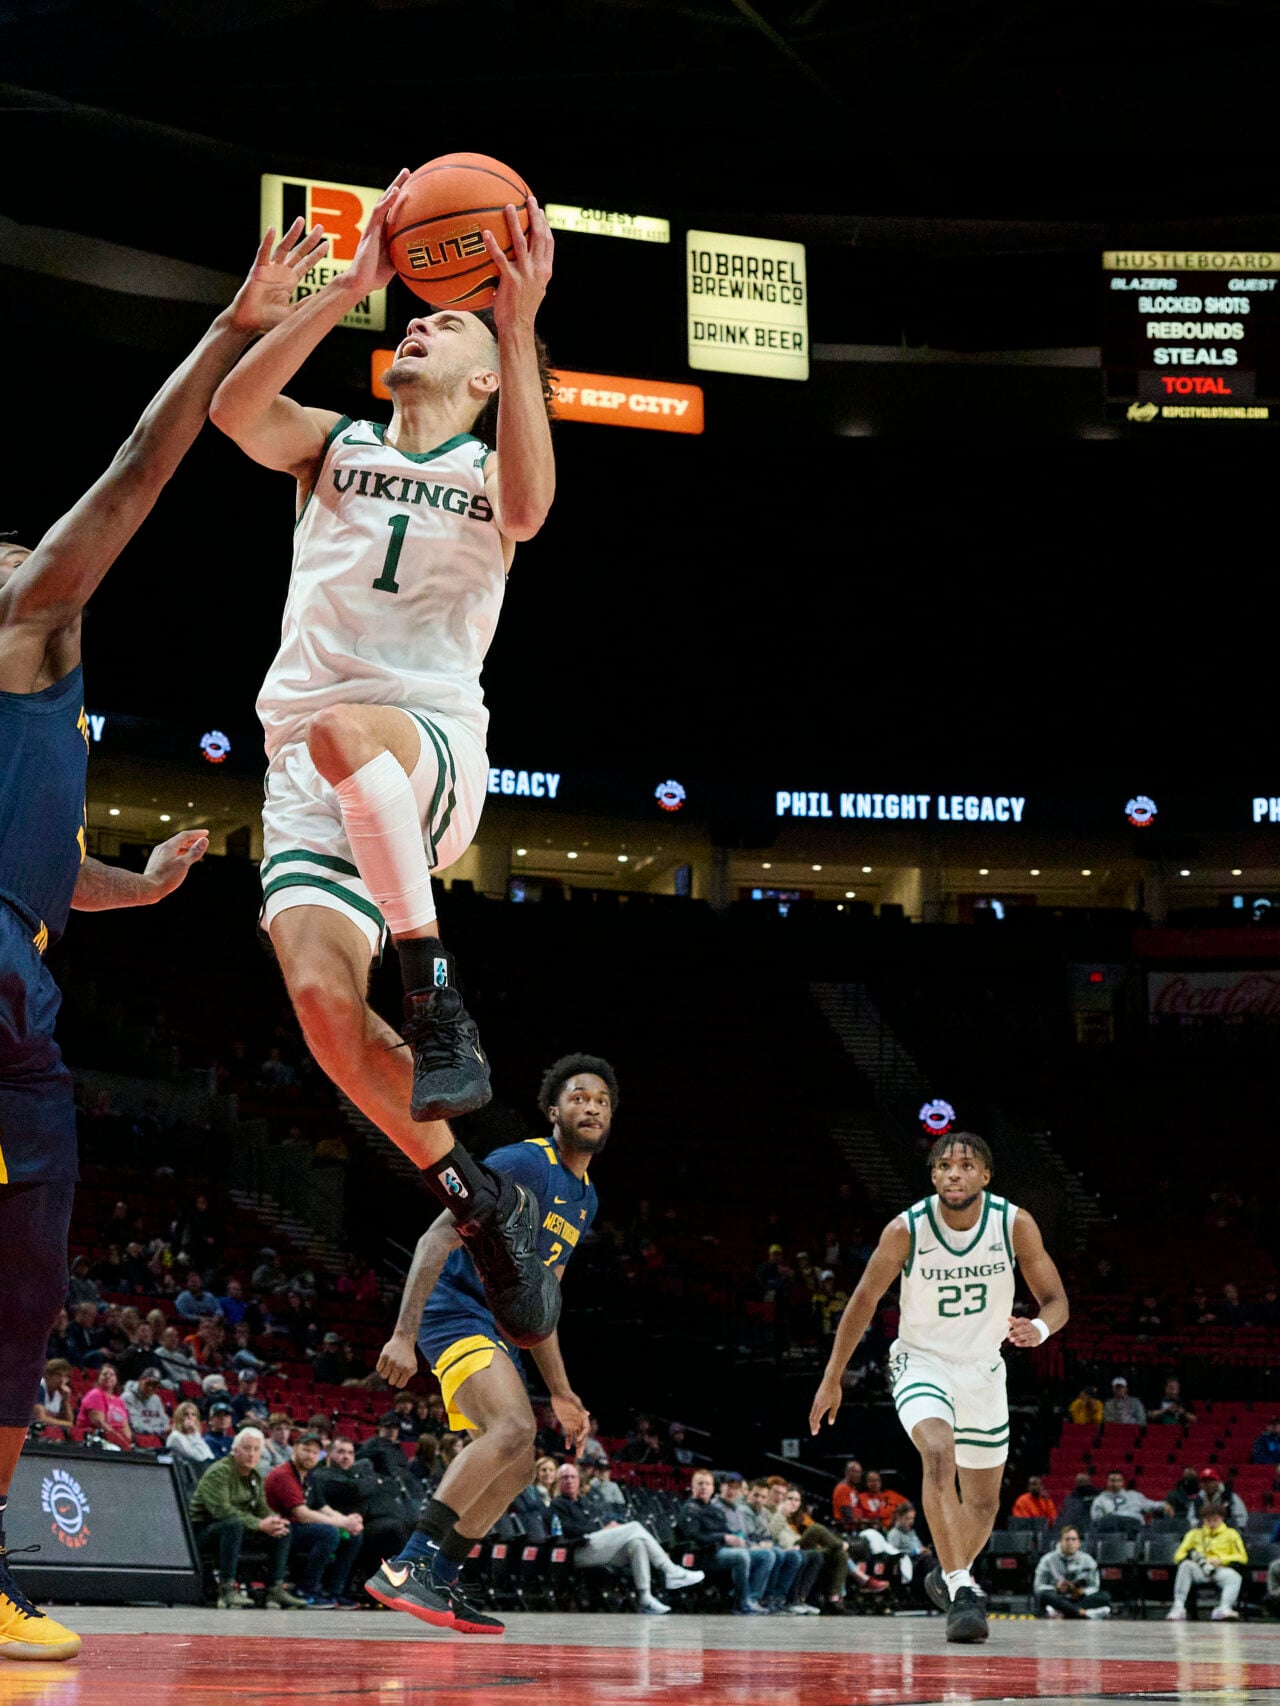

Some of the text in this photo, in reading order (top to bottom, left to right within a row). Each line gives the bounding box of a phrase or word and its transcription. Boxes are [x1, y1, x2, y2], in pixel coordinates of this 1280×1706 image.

[579, 208, 638, 226] GUEST
[407, 230, 487, 270] ELITE
[1115, 253, 1273, 269] HUSTLEBOARD
[1110, 277, 1178, 291] BLAZERS
[1227, 278, 1278, 292] GUEST
[1138, 296, 1251, 315] BLOCKED SHOTS
[693, 321, 803, 352] DRINK BEER
[1146, 321, 1245, 340] REBOUNDS
[1153, 347, 1238, 366] STEALS
[1161, 376, 1233, 395] TOTAL
[557, 386, 578, 404] OF
[580, 388, 627, 409] RIP
[628, 394, 689, 416] CITY
[333, 469, 494, 522] VIKINGS
[372, 514, 410, 593] 1
[487, 768, 560, 798] EGACY
[776, 791, 1025, 822] PHIL KNIGHT LEGACY
[1253, 797, 1280, 823] PH
[543, 1211, 565, 1236] WEST
[921, 1262, 1005, 1280] VIKINGS
[938, 1283, 987, 1318] 23
